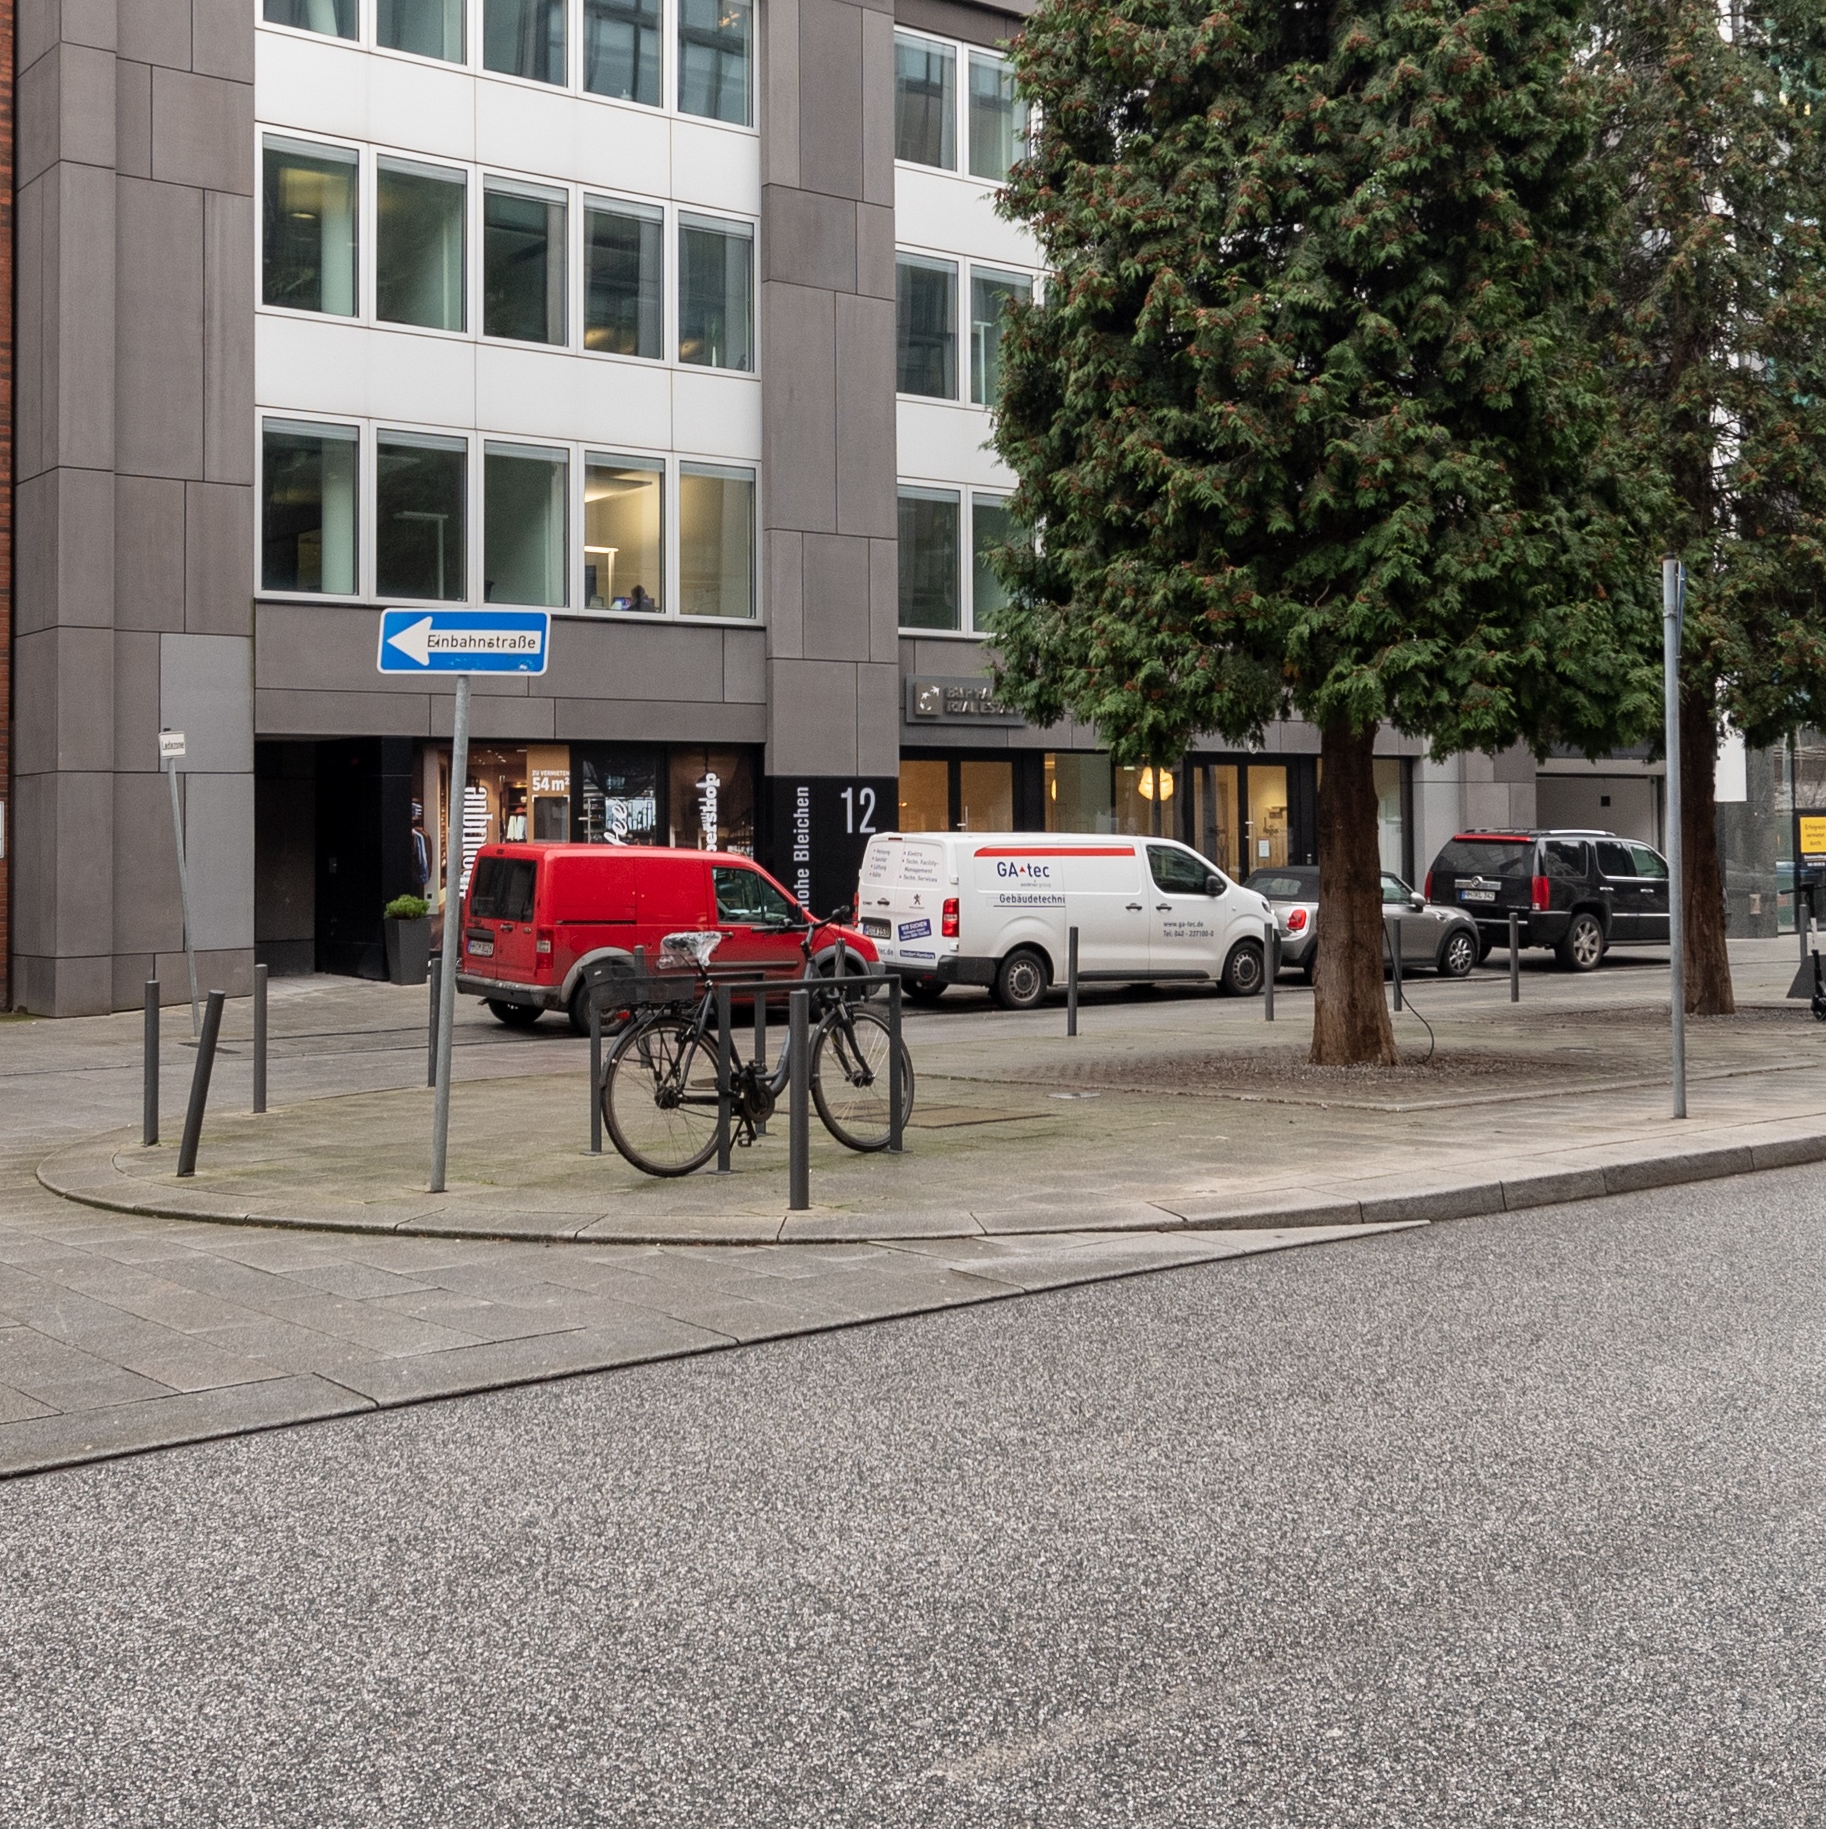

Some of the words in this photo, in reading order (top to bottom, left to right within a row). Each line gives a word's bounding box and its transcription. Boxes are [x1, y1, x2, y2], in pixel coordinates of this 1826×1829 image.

[427, 634, 537, 650] Einbahnstraße
[532, 777, 550, 792] 54
[793, 786, 810, 862] Bleichen
[840, 787, 876, 834] 12
